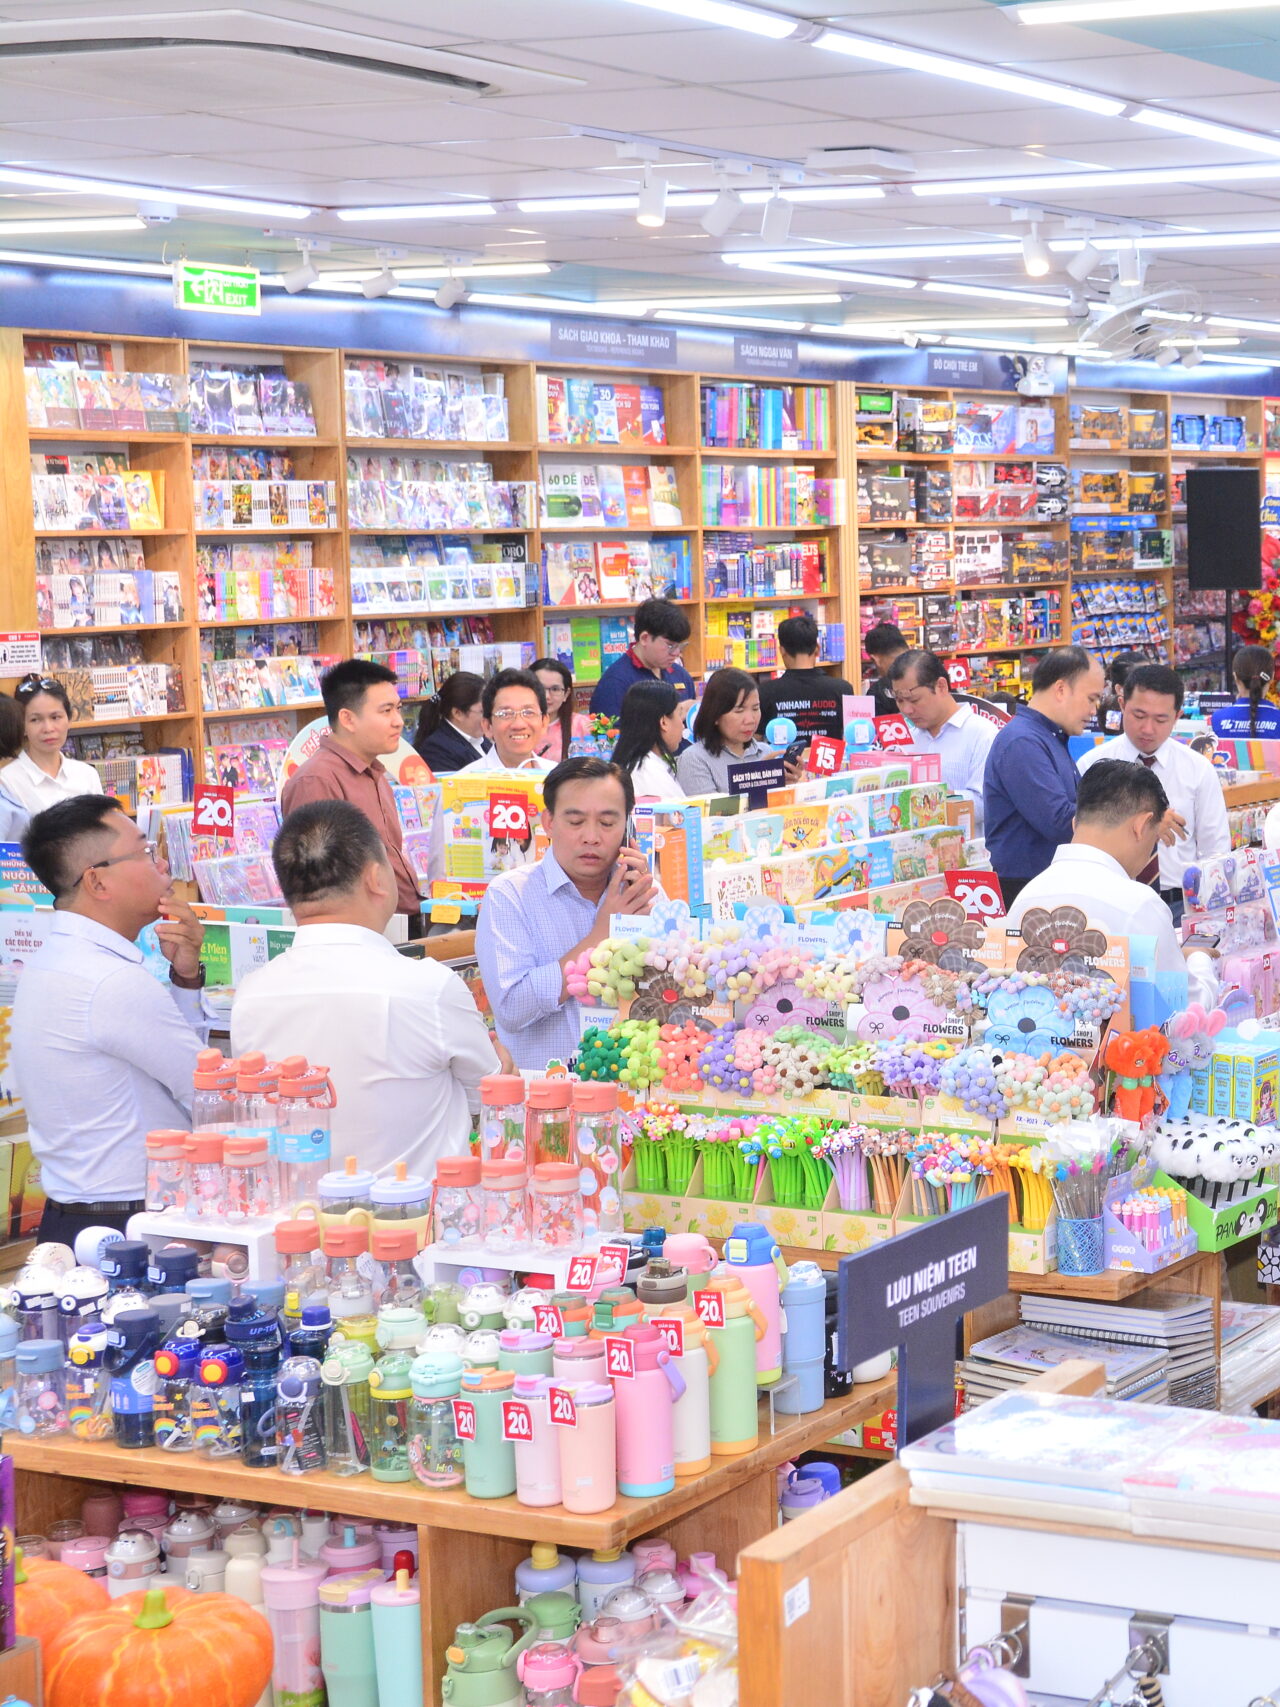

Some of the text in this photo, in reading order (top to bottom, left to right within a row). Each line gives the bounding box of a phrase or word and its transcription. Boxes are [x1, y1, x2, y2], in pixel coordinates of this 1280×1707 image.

[225, 294, 247, 305] EXIT
[628, 334, 649, 346] THAM
[776, 700, 836, 710] VINHANH AUDIO
[954, 885, 1004, 915] 20%
[1083, 956, 1125, 968] FLOWERS
[806, 1016, 845, 1028] FLOWERS
[923, 1024, 964, 1035] FLOWERS
[1051, 1037, 1093, 1048] FLOWERS
[886, 1245, 977, 1308] LƯU NIỆM TEEN
[898, 1283, 966, 1328] TEEN SOUVENIRS
